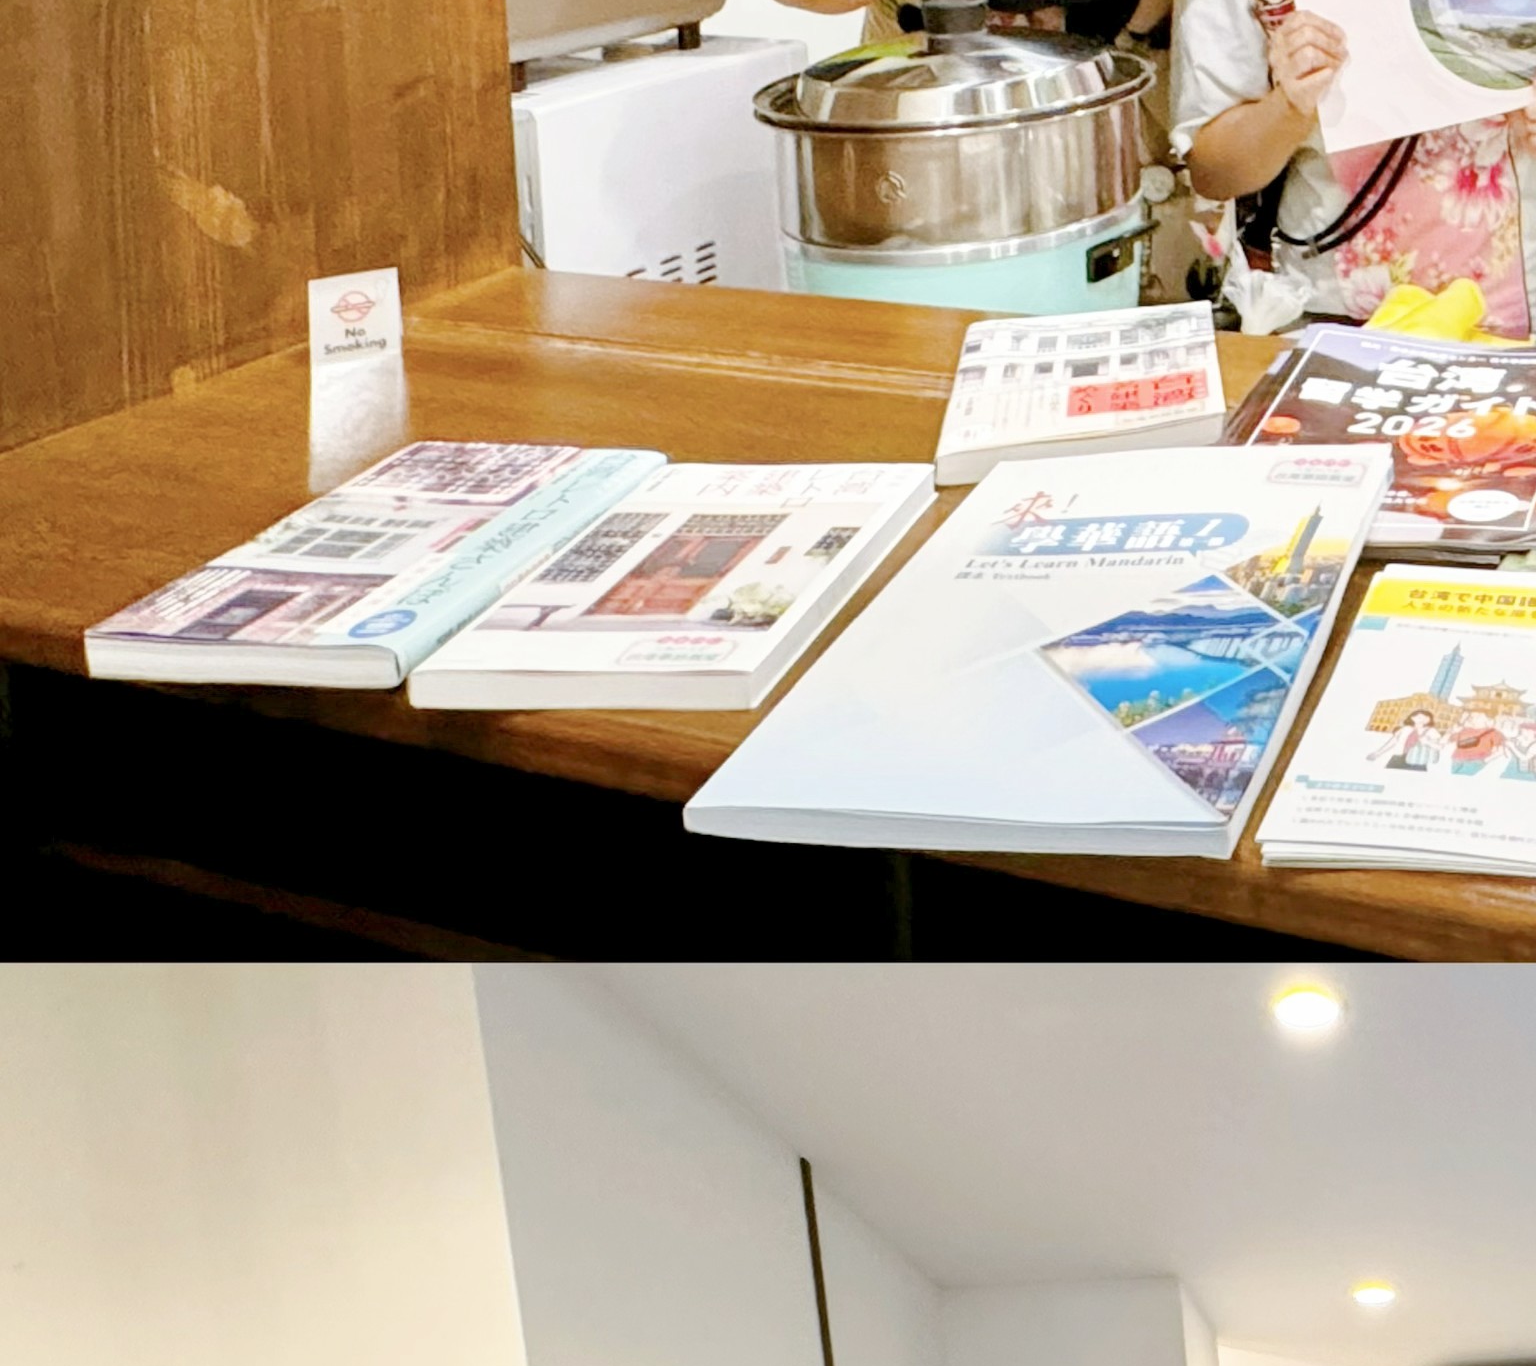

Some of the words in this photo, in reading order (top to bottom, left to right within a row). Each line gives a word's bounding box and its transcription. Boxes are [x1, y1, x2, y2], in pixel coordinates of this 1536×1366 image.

[345, 326, 366, 339] No
[324, 338, 388, 356] Smoking
[1346, 411, 1478, 439] 2026
[1009, 519, 1186, 553] 學華語
[964, 558, 1012, 570] Let's
[1018, 557, 1078, 569] Learn
[1087, 553, 1185, 568] Mandarin
